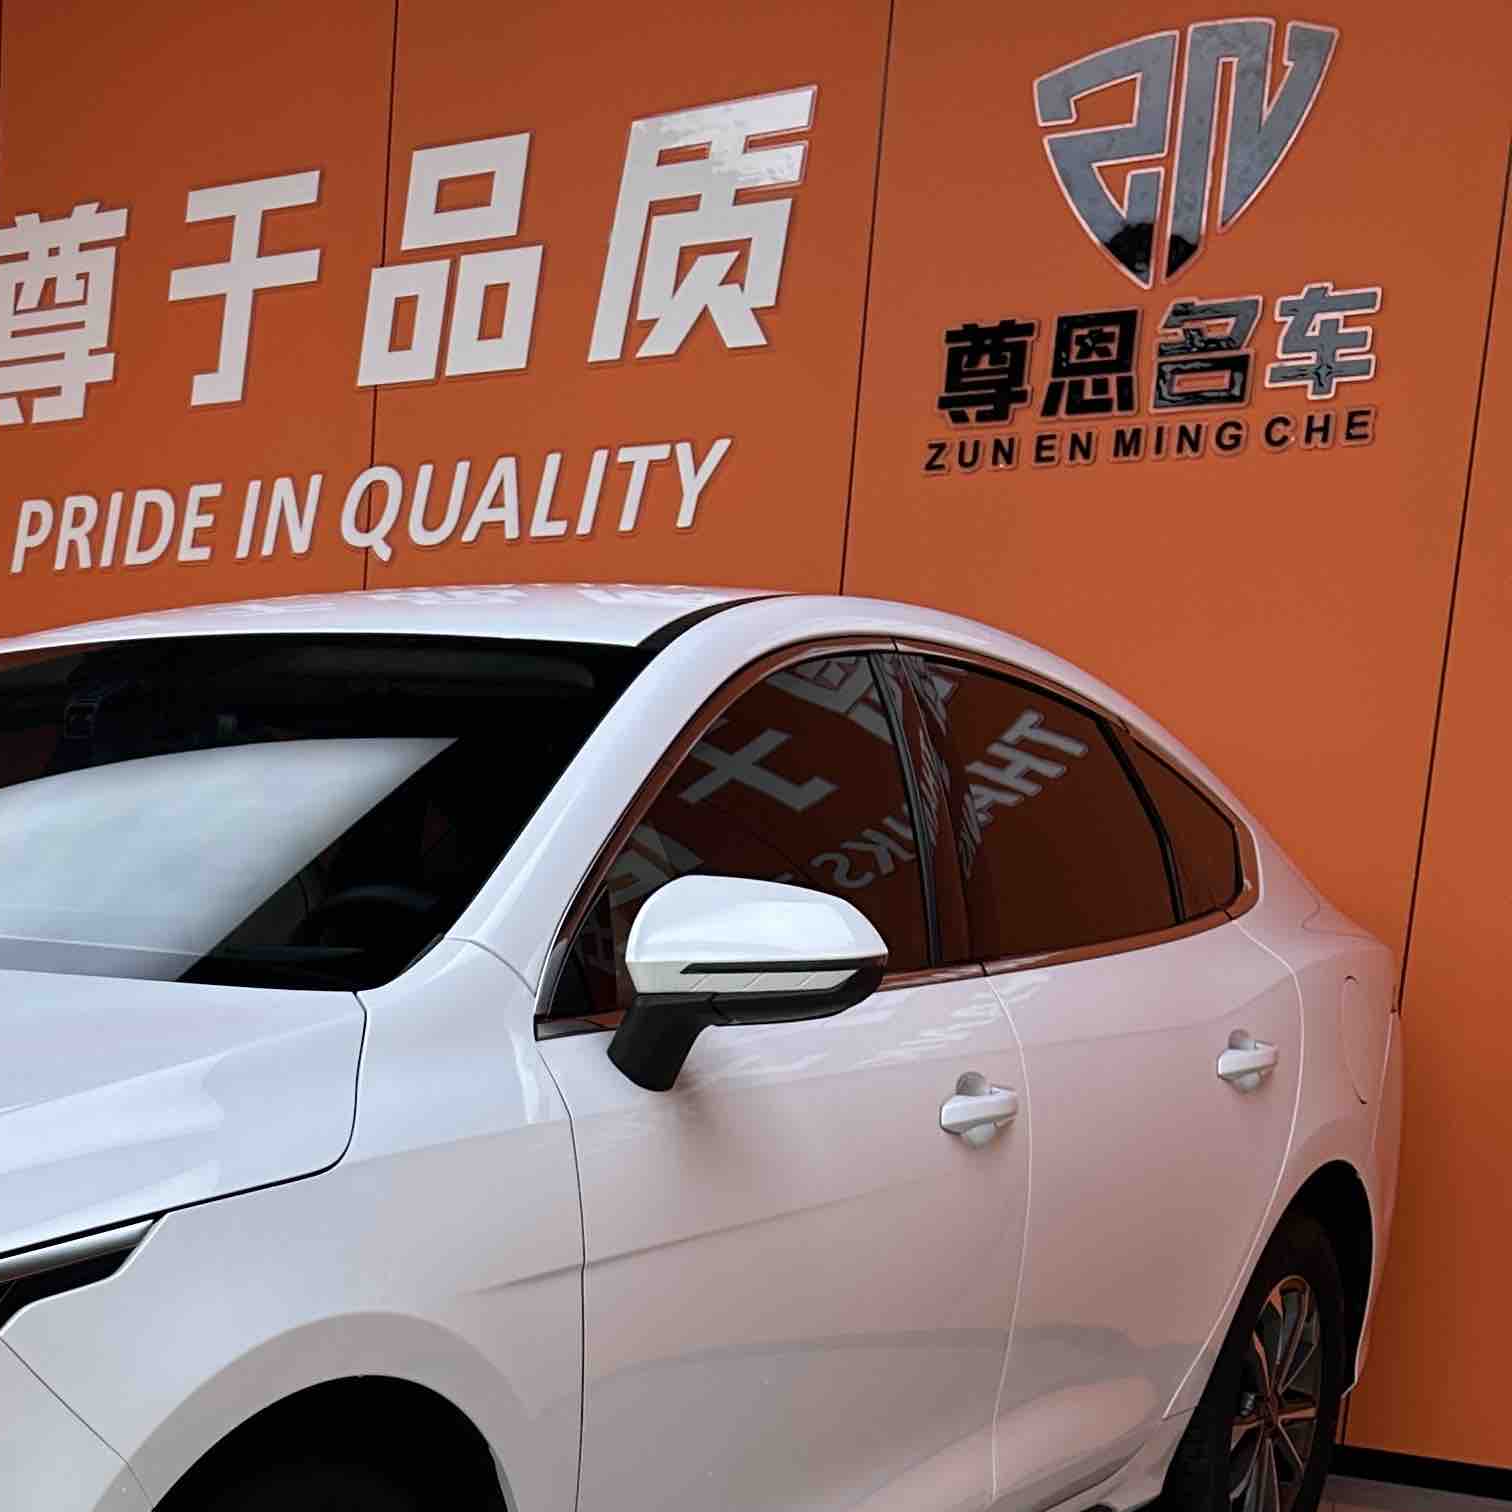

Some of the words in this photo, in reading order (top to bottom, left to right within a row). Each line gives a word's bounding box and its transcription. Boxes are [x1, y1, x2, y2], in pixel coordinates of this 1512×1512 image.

[936, 283, 1382, 425] 尊恩名车
[11, 482, 222, 574] PRIDE
[236, 474, 322, 559] IN
[340, 437, 732, 562] QUALITY
[922, 435, 1018, 474] ZUN
[1033, 430, 1093, 465] EN
[1111, 419, 1244, 460] MING
[1263, 408, 1373, 449] CHE
